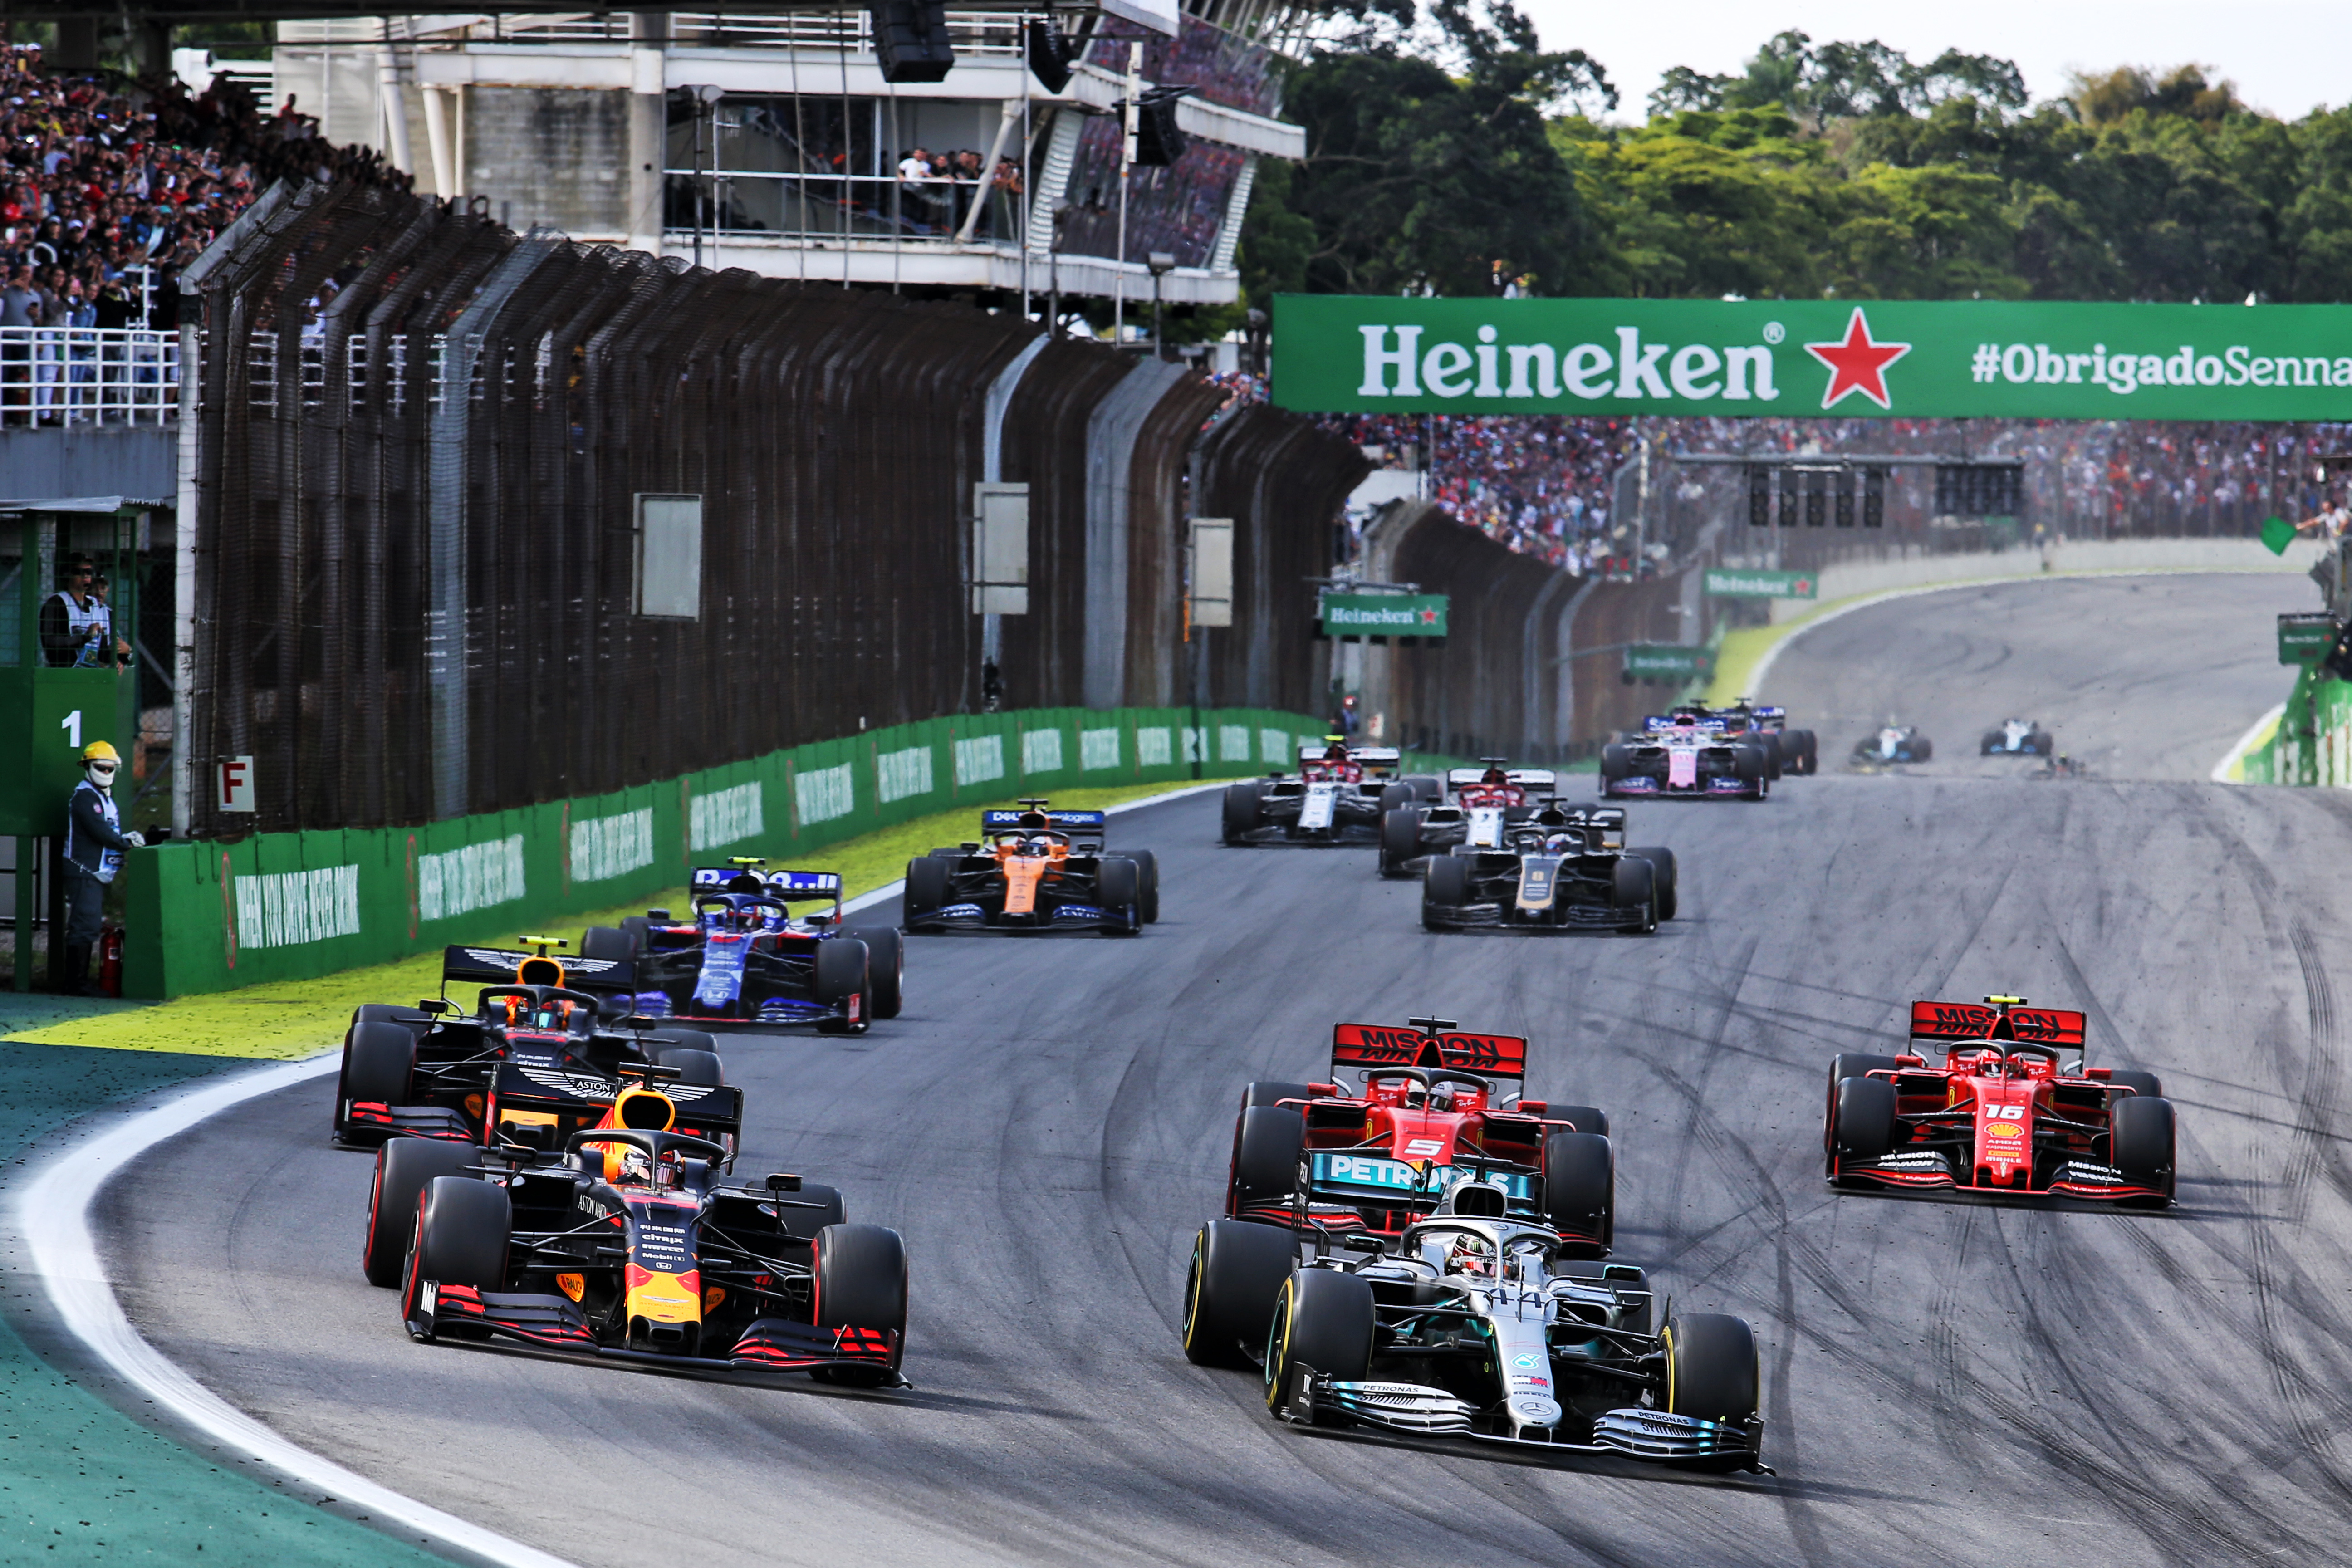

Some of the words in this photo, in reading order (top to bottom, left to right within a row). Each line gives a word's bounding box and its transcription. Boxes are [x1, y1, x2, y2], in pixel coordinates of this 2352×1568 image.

[1358, 324, 1779, 401] Heineken
[1331, 607, 1414, 624] Heineken
[62, 710, 81, 747] 1
[222, 763, 245, 804] F
[577, 1081, 610, 1091] ASTON
[1984, 1103, 2026, 1120] 16
[1403, 1138, 1446, 1156] 5
[1880, 1151, 1936, 1160] MISSION
[2068, 1161, 2122, 1175] MISSION
[1489, 1288, 1545, 1308] 44
[1363, 1385, 1419, 1393] PETRONAS
[1638, 1411, 1689, 1425] PETRONAS
